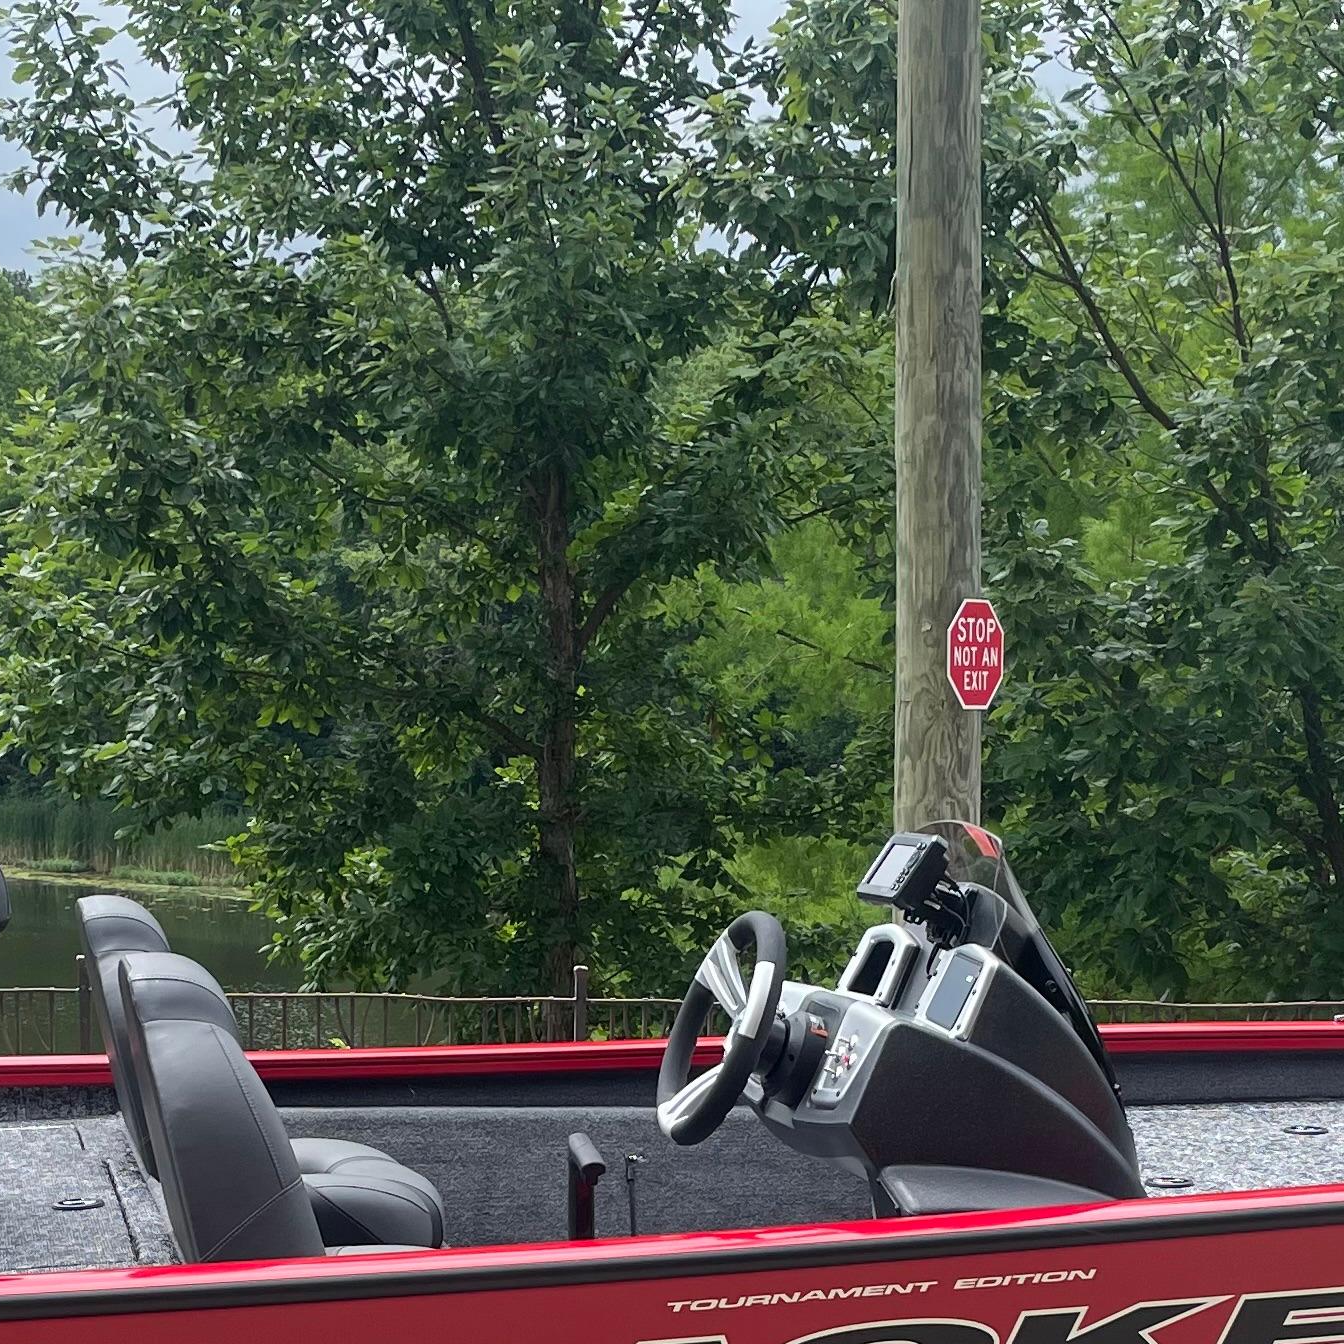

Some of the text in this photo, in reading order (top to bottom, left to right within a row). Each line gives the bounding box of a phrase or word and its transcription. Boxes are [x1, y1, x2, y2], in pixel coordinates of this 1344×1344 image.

[957, 617, 996, 642] STOP
[953, 646, 998, 667] NOT AN
[964, 671, 989, 691] EXIT
[667, 1269, 1097, 1313] TOURNAMENT EDITION
